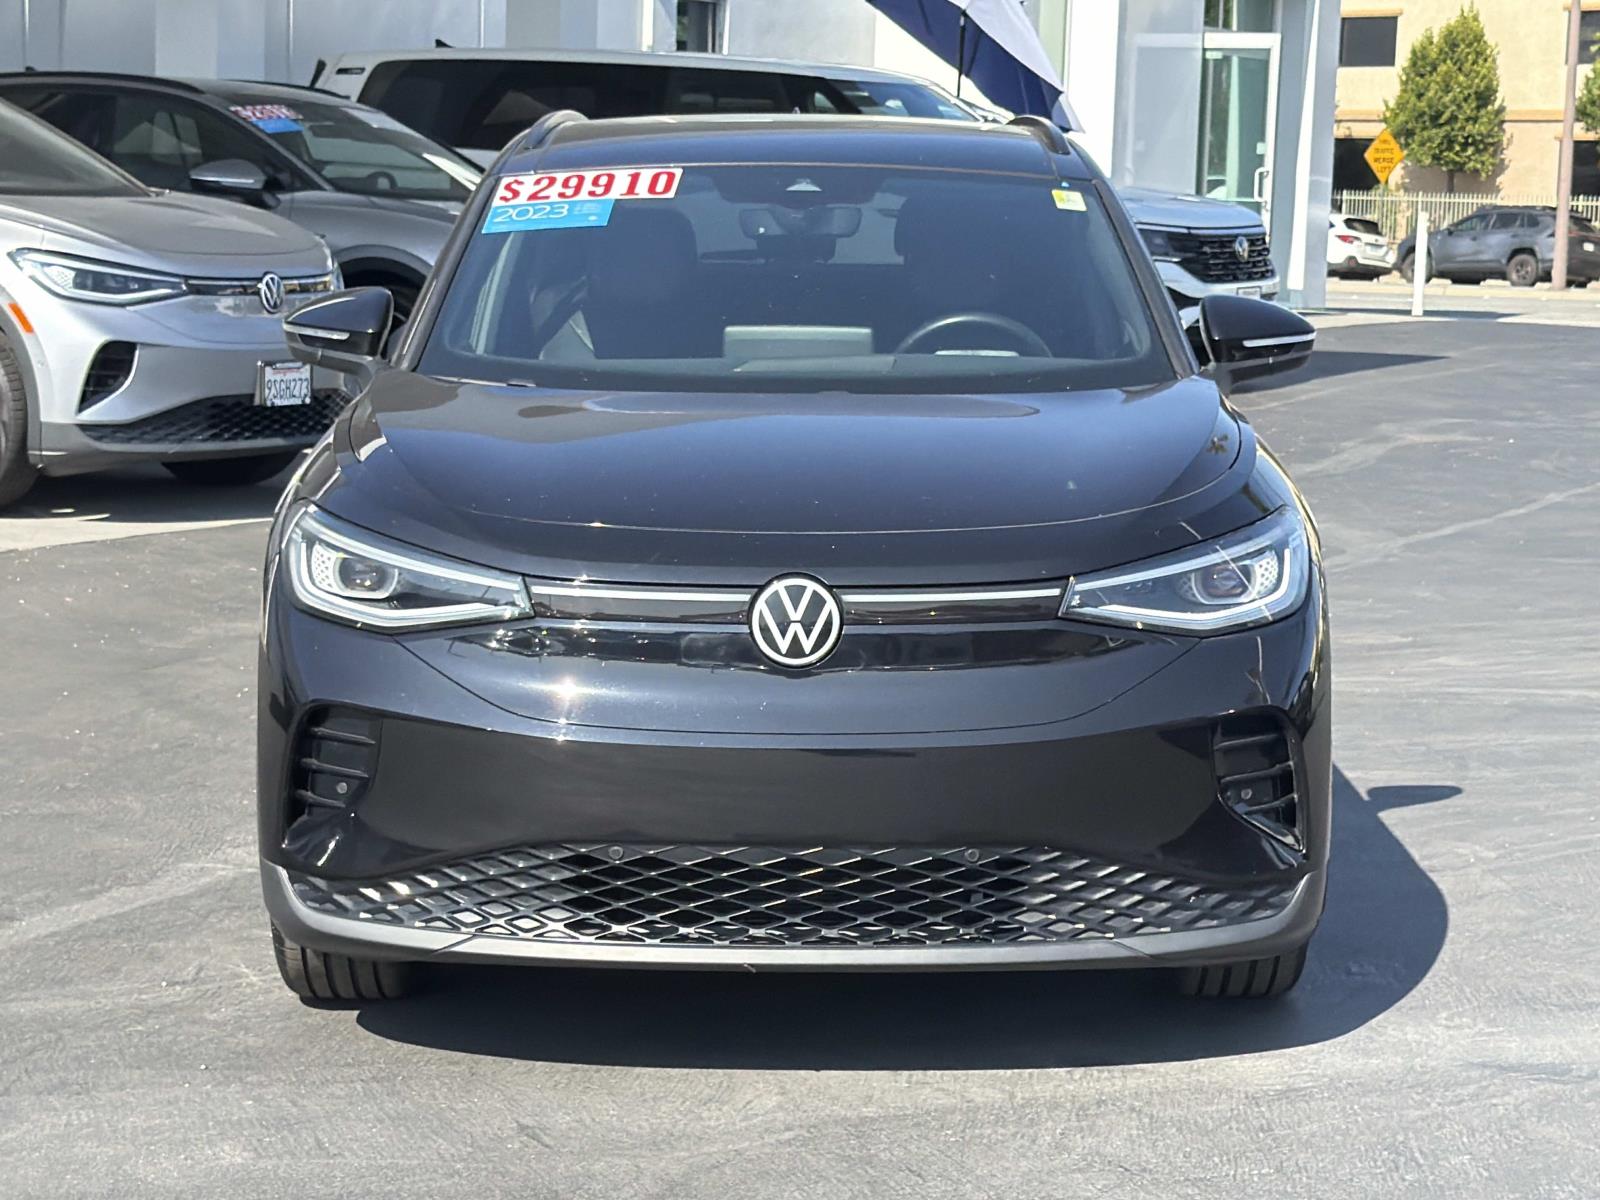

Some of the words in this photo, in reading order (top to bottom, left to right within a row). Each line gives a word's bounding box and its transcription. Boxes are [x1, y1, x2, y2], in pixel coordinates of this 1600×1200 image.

[499, 170, 677, 203] $29910
[493, 204, 570, 222] 2023
[757, 580, 835, 657] VW
